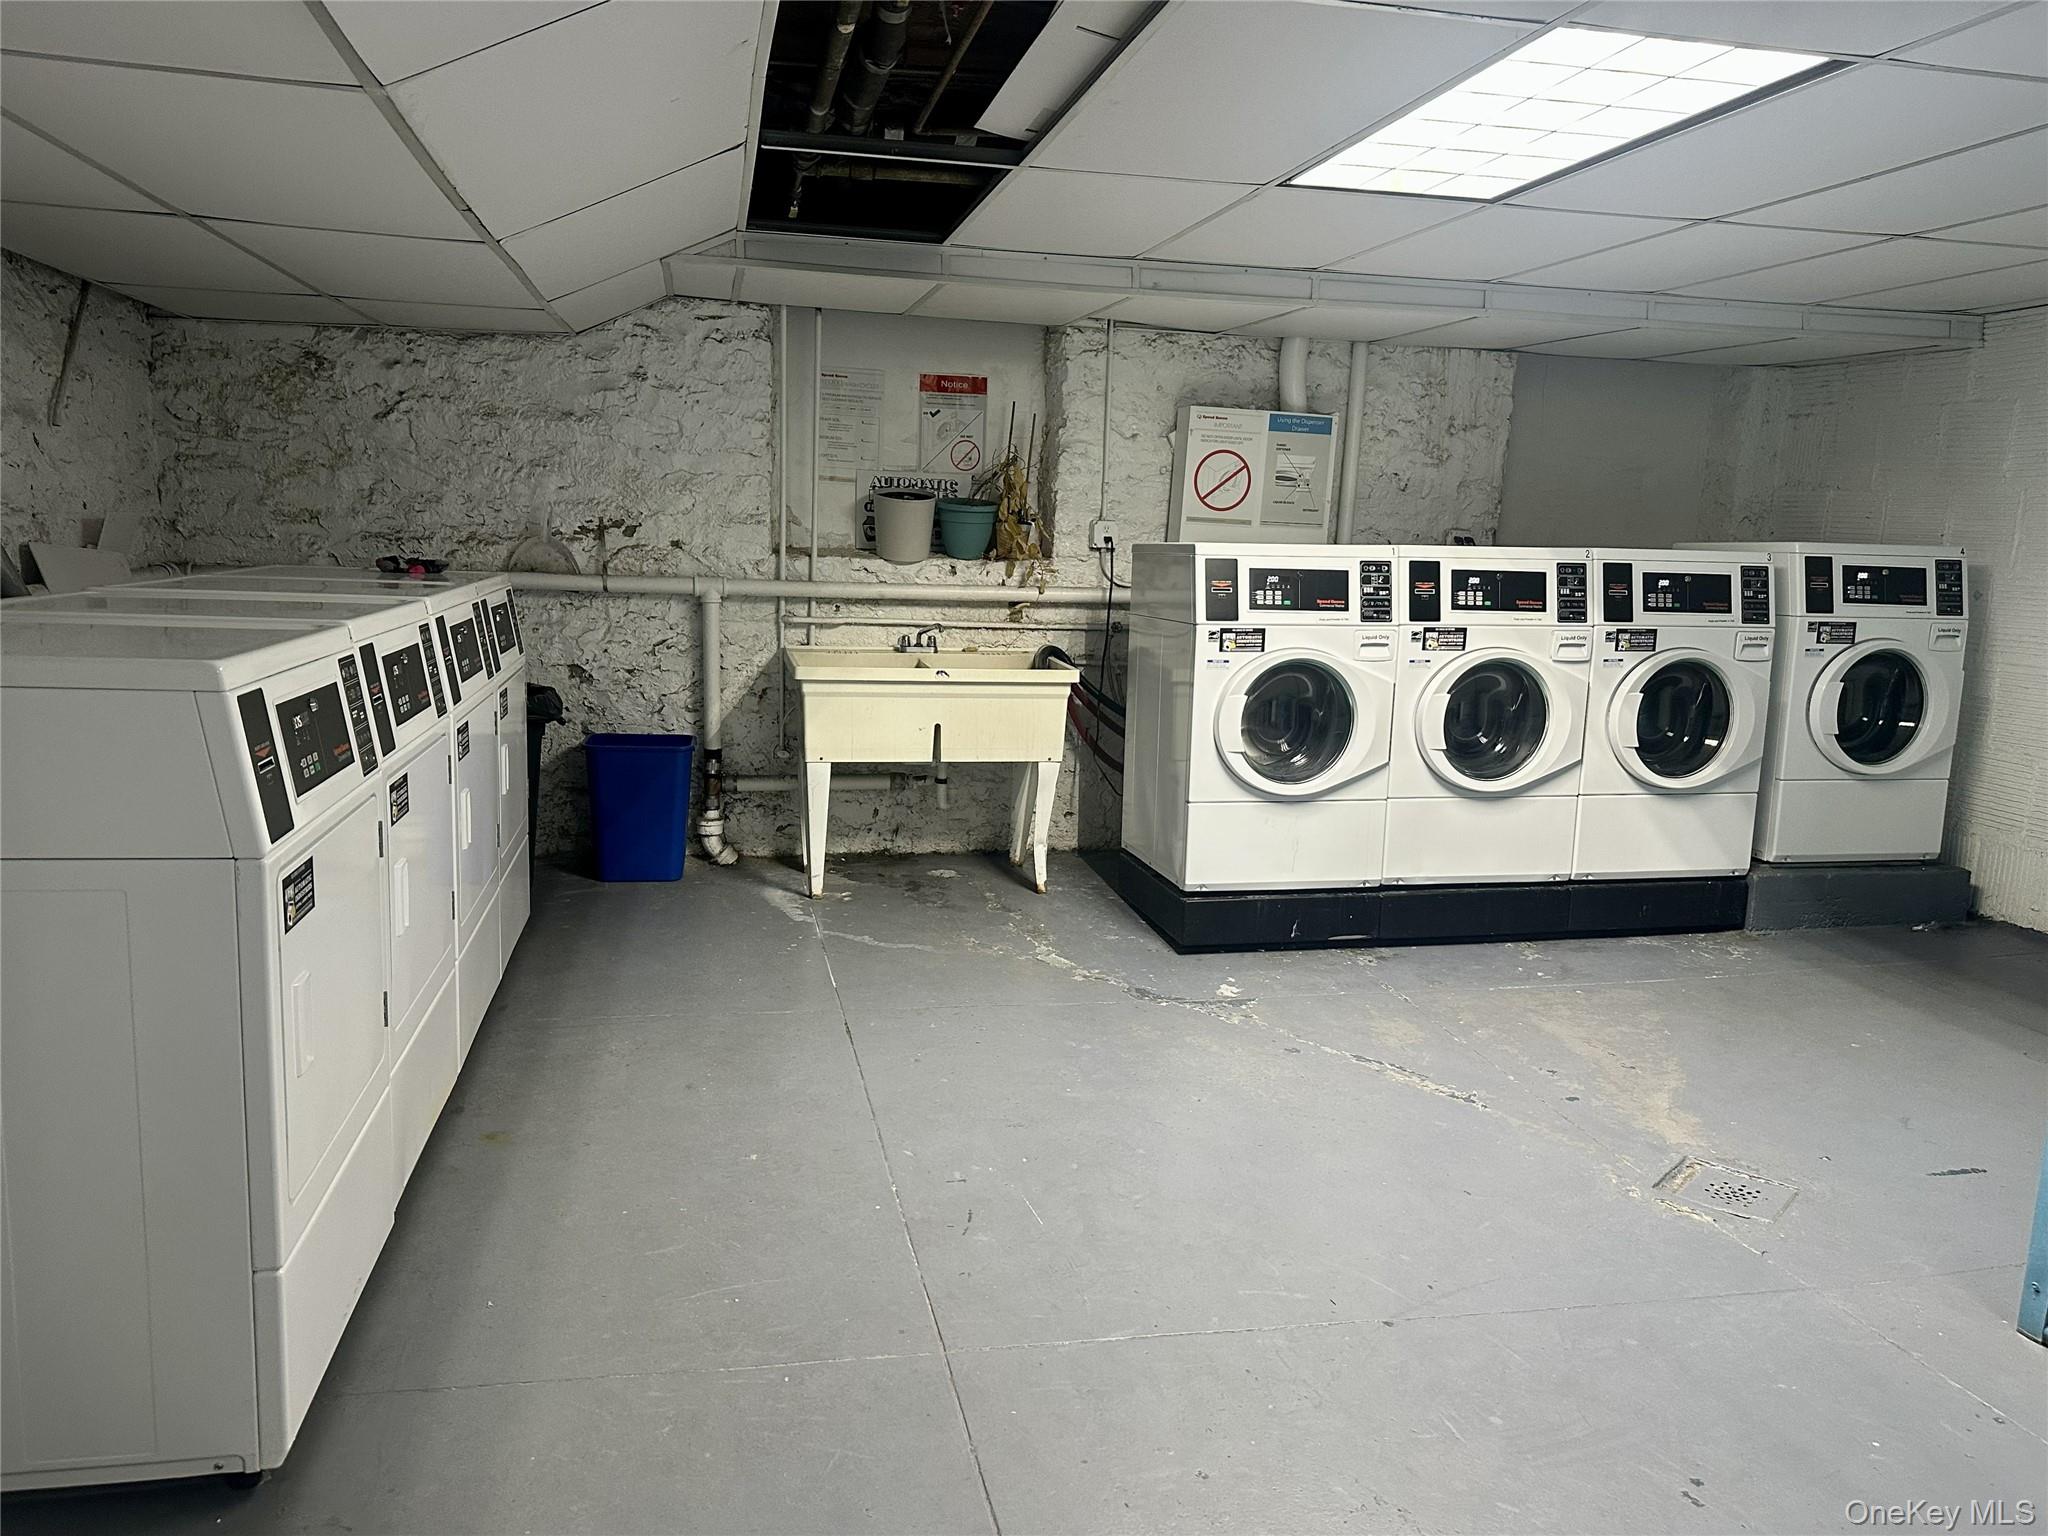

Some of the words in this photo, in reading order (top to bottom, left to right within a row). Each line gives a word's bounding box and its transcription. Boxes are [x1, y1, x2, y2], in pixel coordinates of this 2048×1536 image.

[940, 380, 969, 389] Notice
[869, 475, 959, 492] AUTOMATIC
[1585, 549, 1591, 559] 2
[1960, 547, 1966, 555] 4
[1766, 552, 1772, 561] 3
